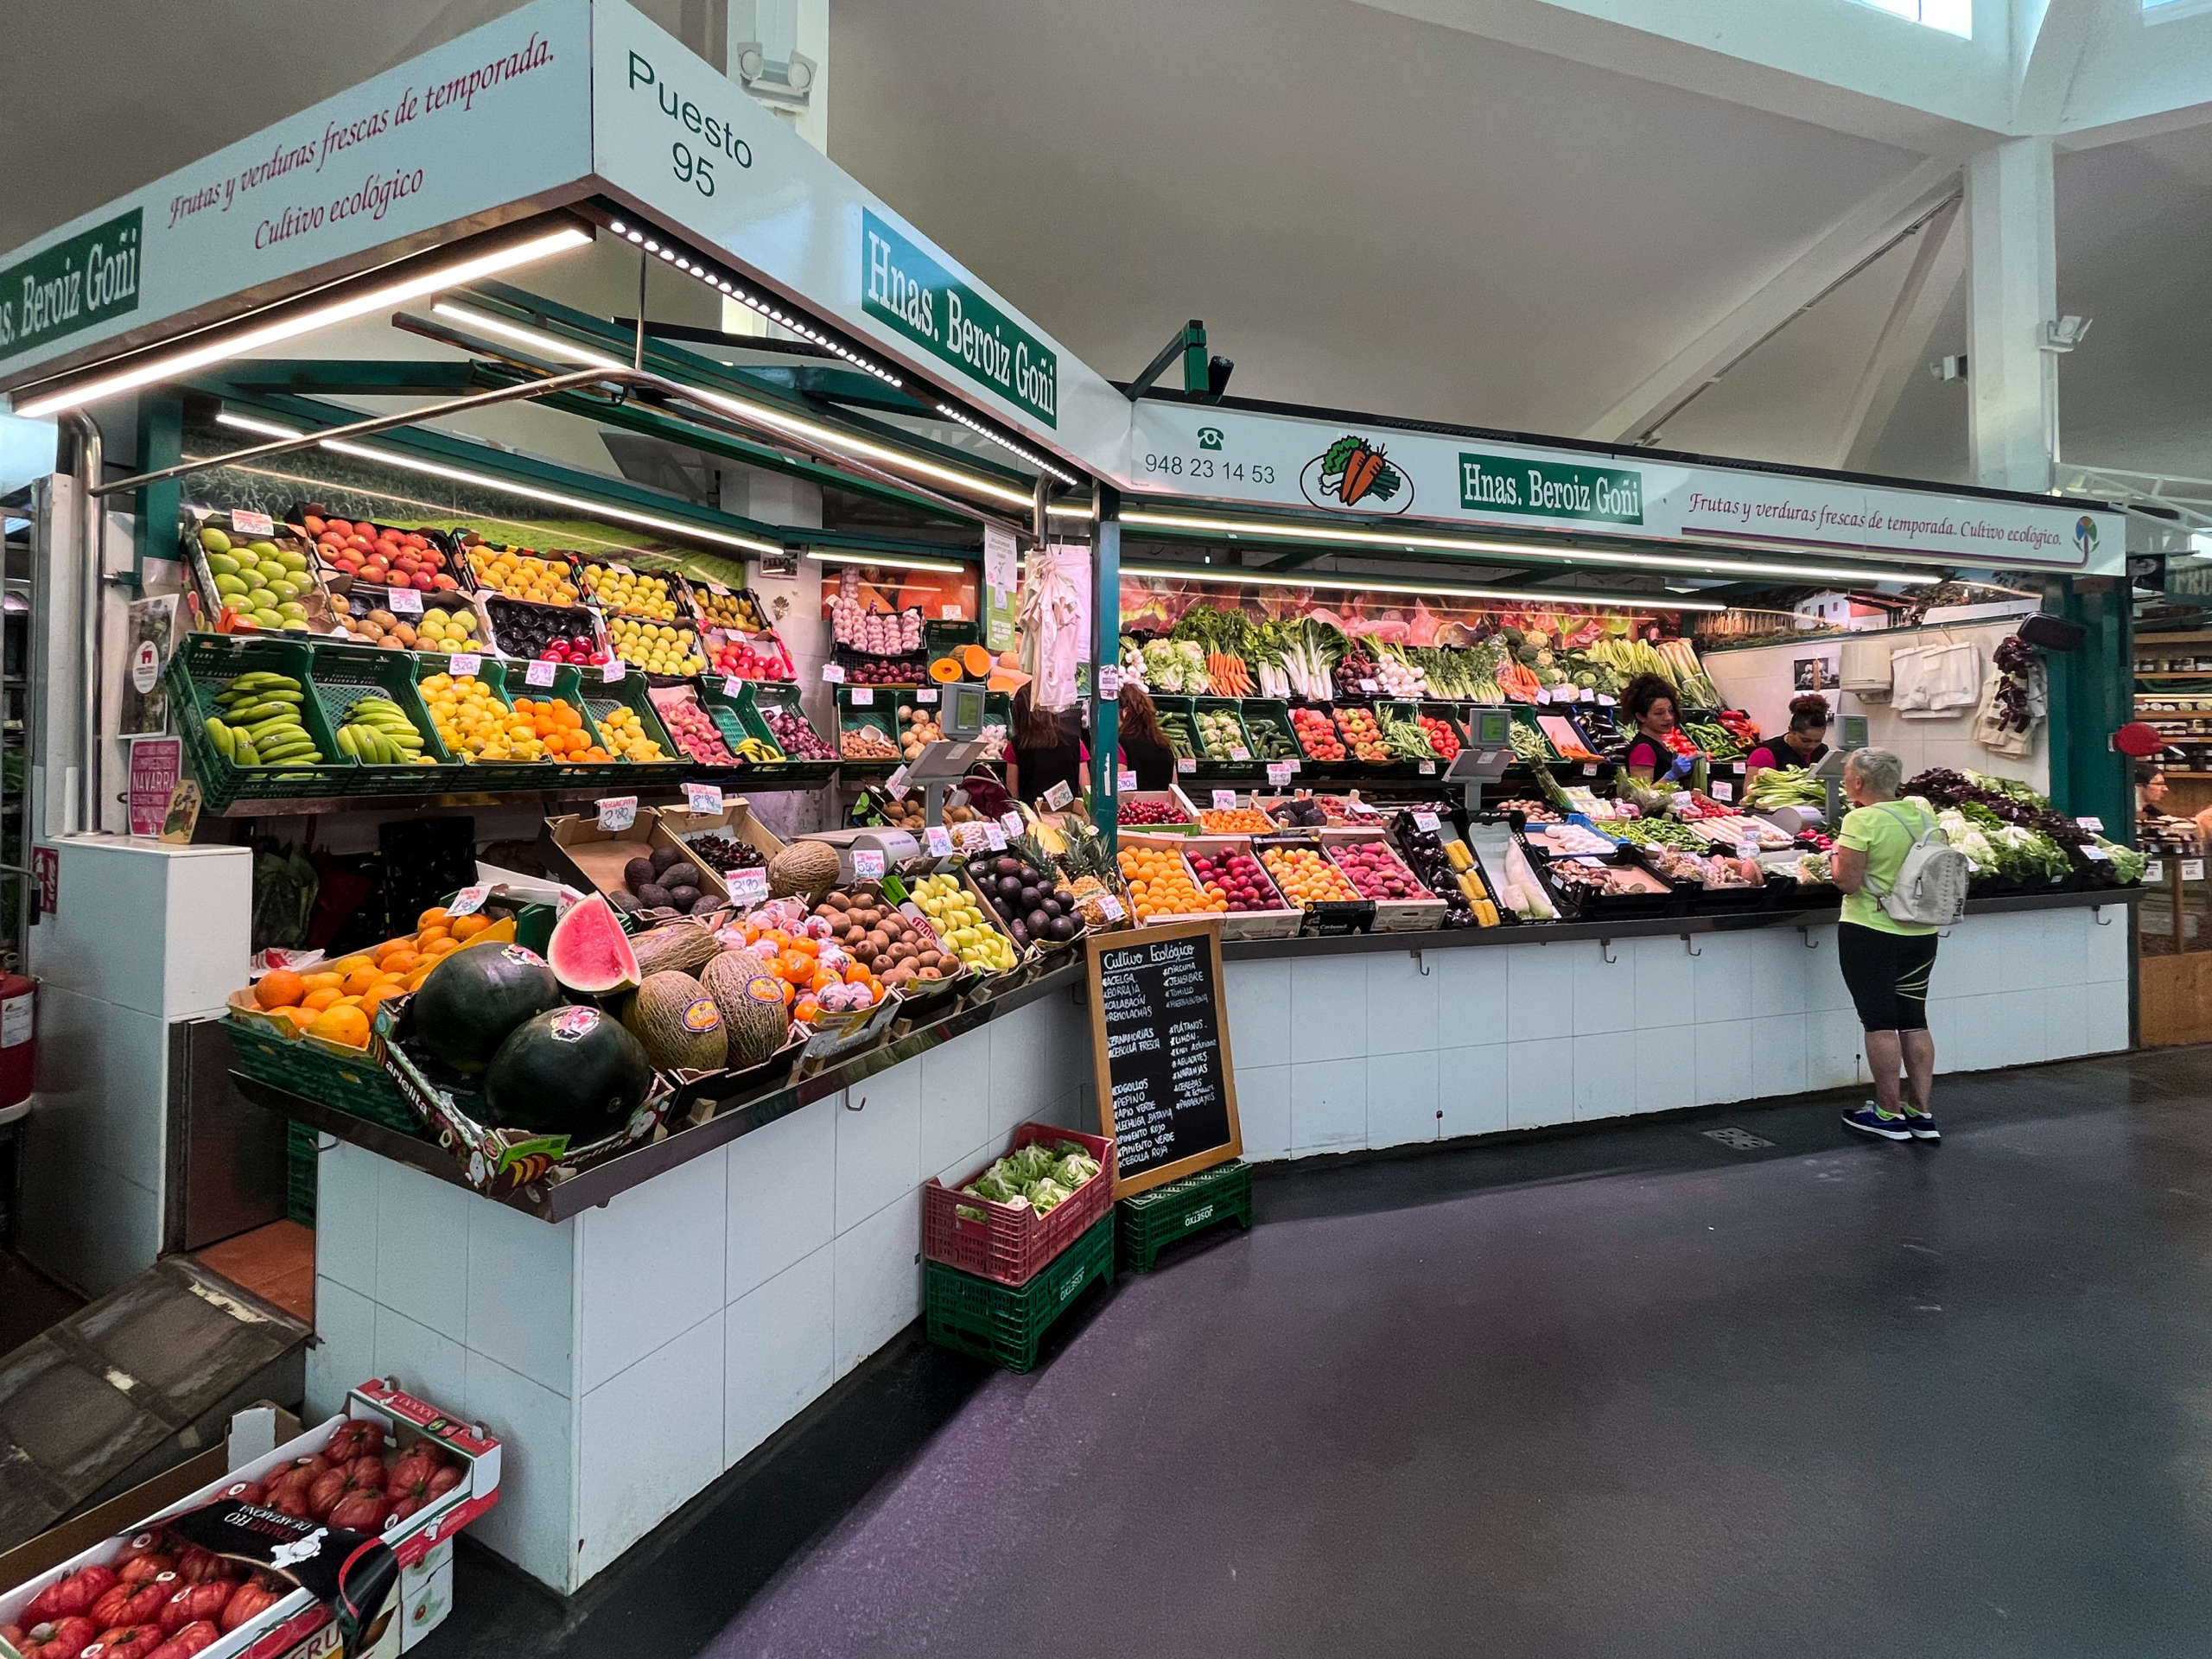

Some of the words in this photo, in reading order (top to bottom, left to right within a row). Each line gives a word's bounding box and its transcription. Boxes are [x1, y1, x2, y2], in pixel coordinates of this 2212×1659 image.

[168, 183, 222, 230] Frutas
[221, 178, 236, 213] y
[240, 143, 316, 193] verduras
[315, 109, 390, 174] frescas
[394, 86, 418, 128] de
[425, 30, 555, 112] temporada.
[628, 49, 753, 169] Puesto
[671, 142, 716, 198] 95
[254, 206, 325, 250] Cultivo
[328, 168, 424, 221] ecológico
[20, 257, 81, 338] Beroiz
[86, 226, 137, 312] Goñi
[867, 230, 940, 343] Hnas.
[945, 288, 1011, 388] Beroiz
[1014, 344, 1054, 418] Goñi
[1145, 453, 1184, 476] 948
[1190, 455, 1214, 480] 23
[1222, 460, 1245, 483] 14
[1250, 463, 1275, 486] 53
[1463, 462, 1522, 506] Hnas.
[1528, 474, 1591, 512] Beroiz
[1594, 480, 1641, 518] Goñi
[1688, 493, 1739, 513] Frutas
[1740, 503, 1752, 523] y
[1755, 499, 1816, 523] verduras
[1815, 505, 1866, 531] frescas
[1867, 511, 1883, 530] de
[1887, 516, 1957, 543] temporada.
[1960, 520, 2005, 541] Cultivo
[2006, 524, 2063, 550] ecológico.
[1103, 951, 1143, 969] Cultivo
[1150, 941, 1195, 963] Ecológico
